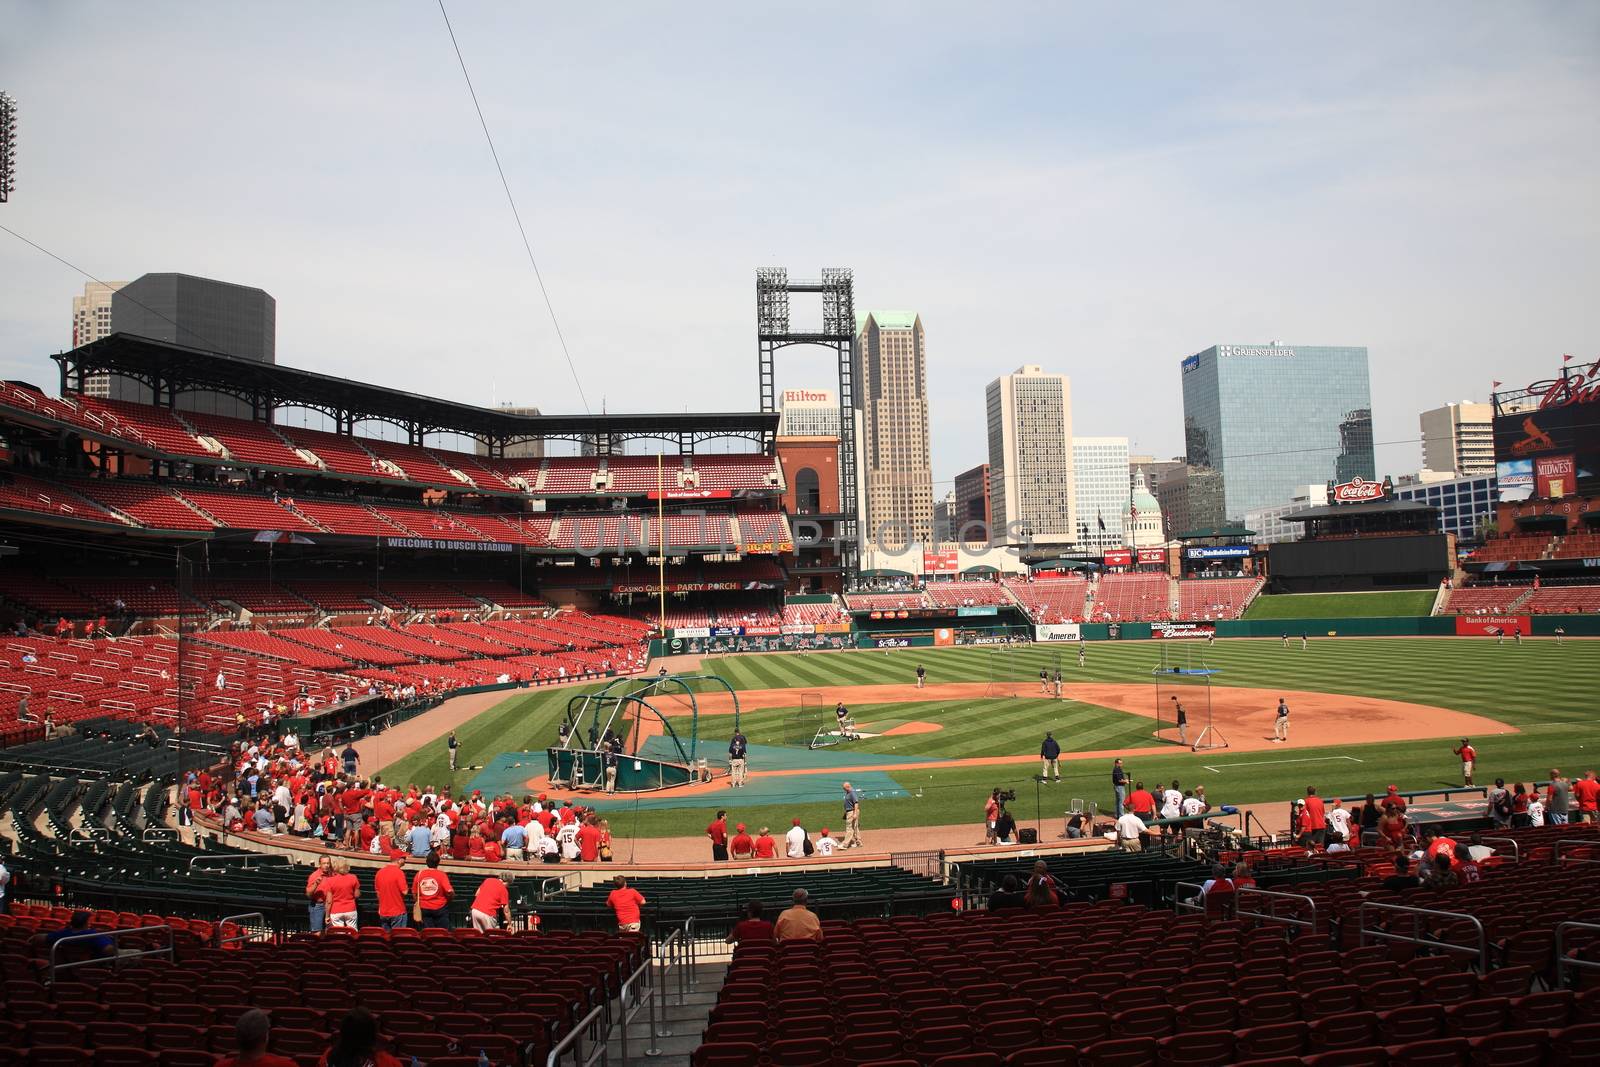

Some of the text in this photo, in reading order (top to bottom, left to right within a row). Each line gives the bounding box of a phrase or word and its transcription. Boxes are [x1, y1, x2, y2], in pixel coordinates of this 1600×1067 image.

[785, 390, 827, 402] Hilton
[1537, 463, 1573, 476] MIDWEST
[387, 537, 513, 552] WELCOME TO BUSCH STADIUM
[677, 583, 704, 591] PARTY
[707, 582, 737, 590] PORCH
[1465, 616, 1483, 624] Bank
[1490, 616, 1518, 624] America
[1048, 632, 1077, 640] Ameren
[1161, 629, 1215, 638] Budweiser
[1172, 797, 1178, 806] 5
[1191, 805, 1197, 813] 5
[1335, 815, 1341, 823] 5
[563, 834, 573, 844] 15
[540, 846, 546, 855] 5
